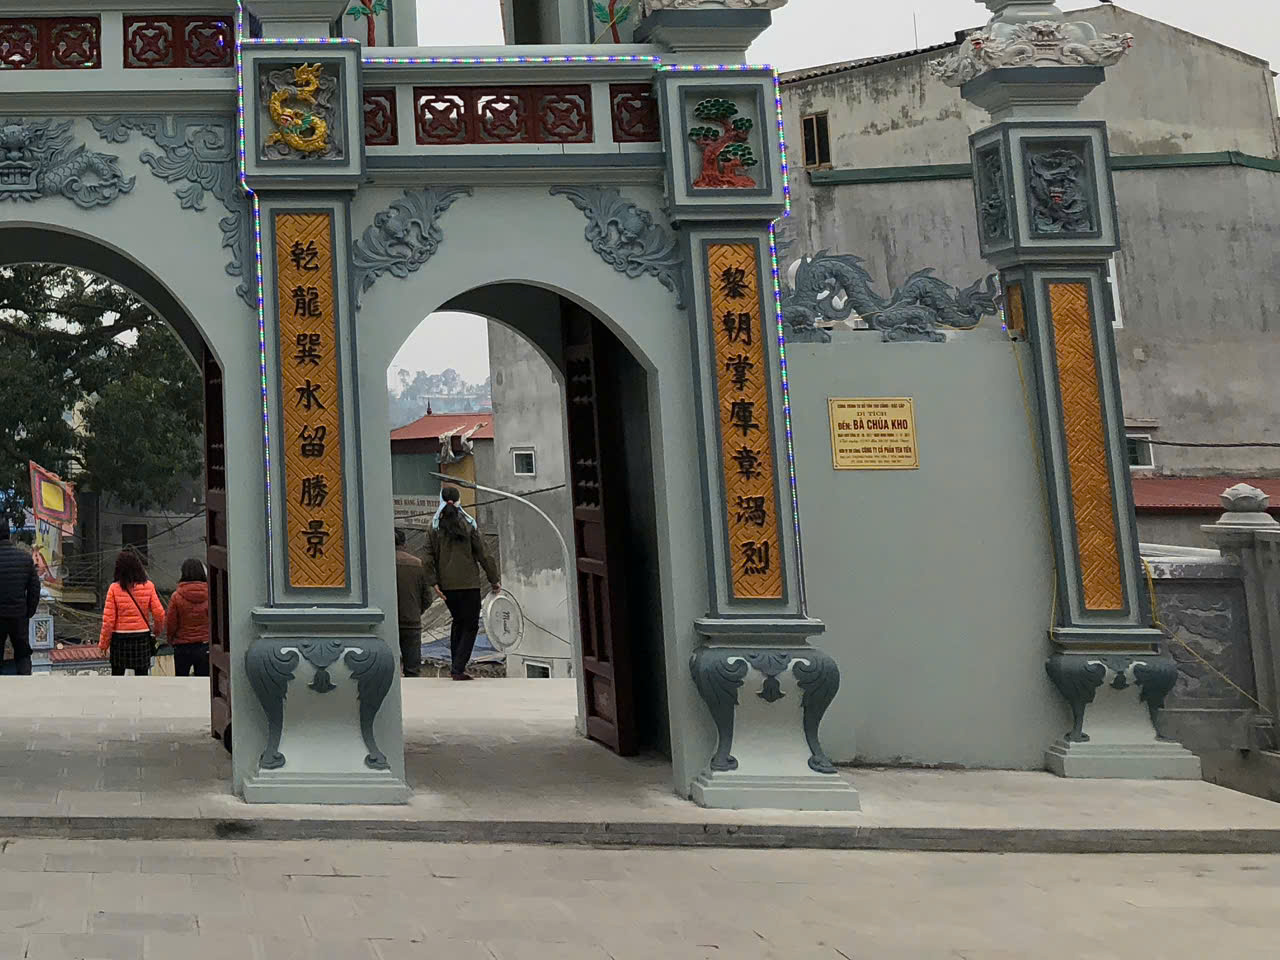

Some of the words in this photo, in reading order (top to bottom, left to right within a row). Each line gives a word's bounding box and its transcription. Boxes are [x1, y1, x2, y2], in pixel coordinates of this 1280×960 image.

[289, 238, 329, 559] 乾龍巽水留勝景
[853, 417, 864, 430] BÀ
[867, 417, 889, 430] CHÚA
[892, 419, 908, 430] KHO
